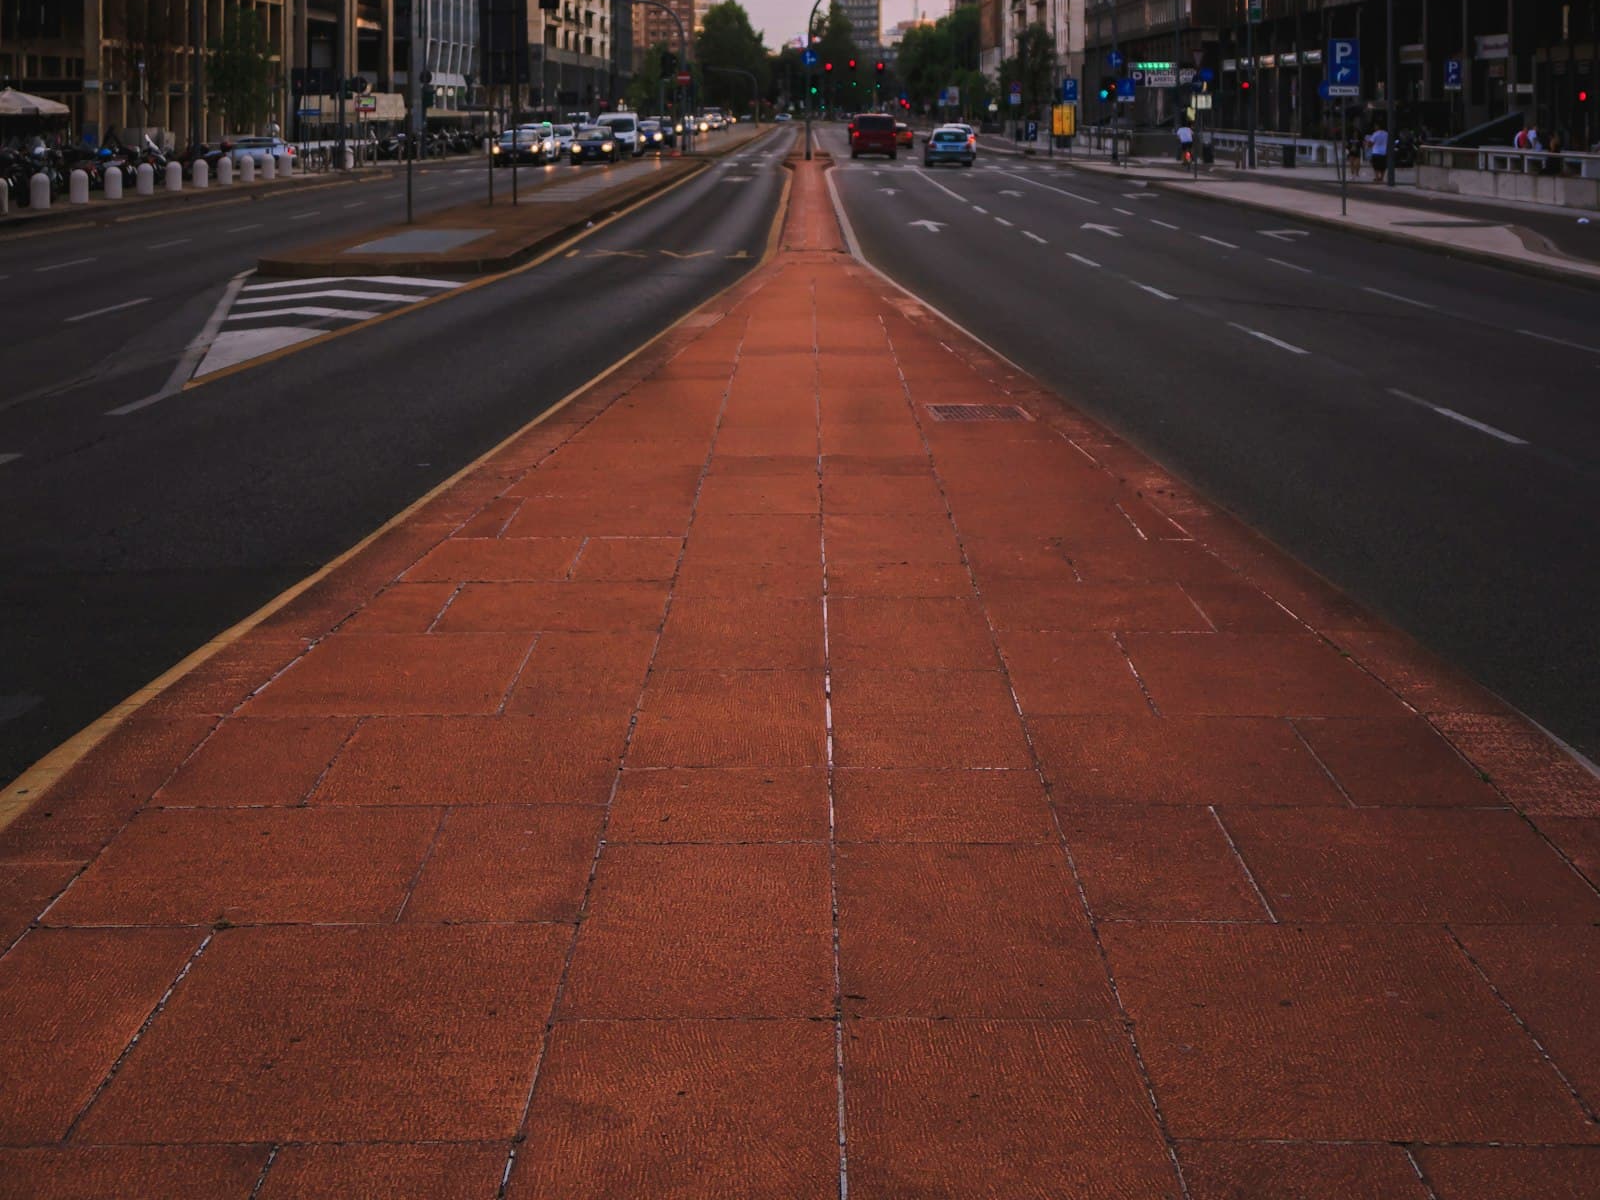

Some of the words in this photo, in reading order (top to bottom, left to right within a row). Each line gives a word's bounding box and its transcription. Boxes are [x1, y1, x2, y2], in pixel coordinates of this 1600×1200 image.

[1336, 42, 1352, 64] P
[1449, 61, 1458, 72] P
[1066, 80, 1074, 90] P
